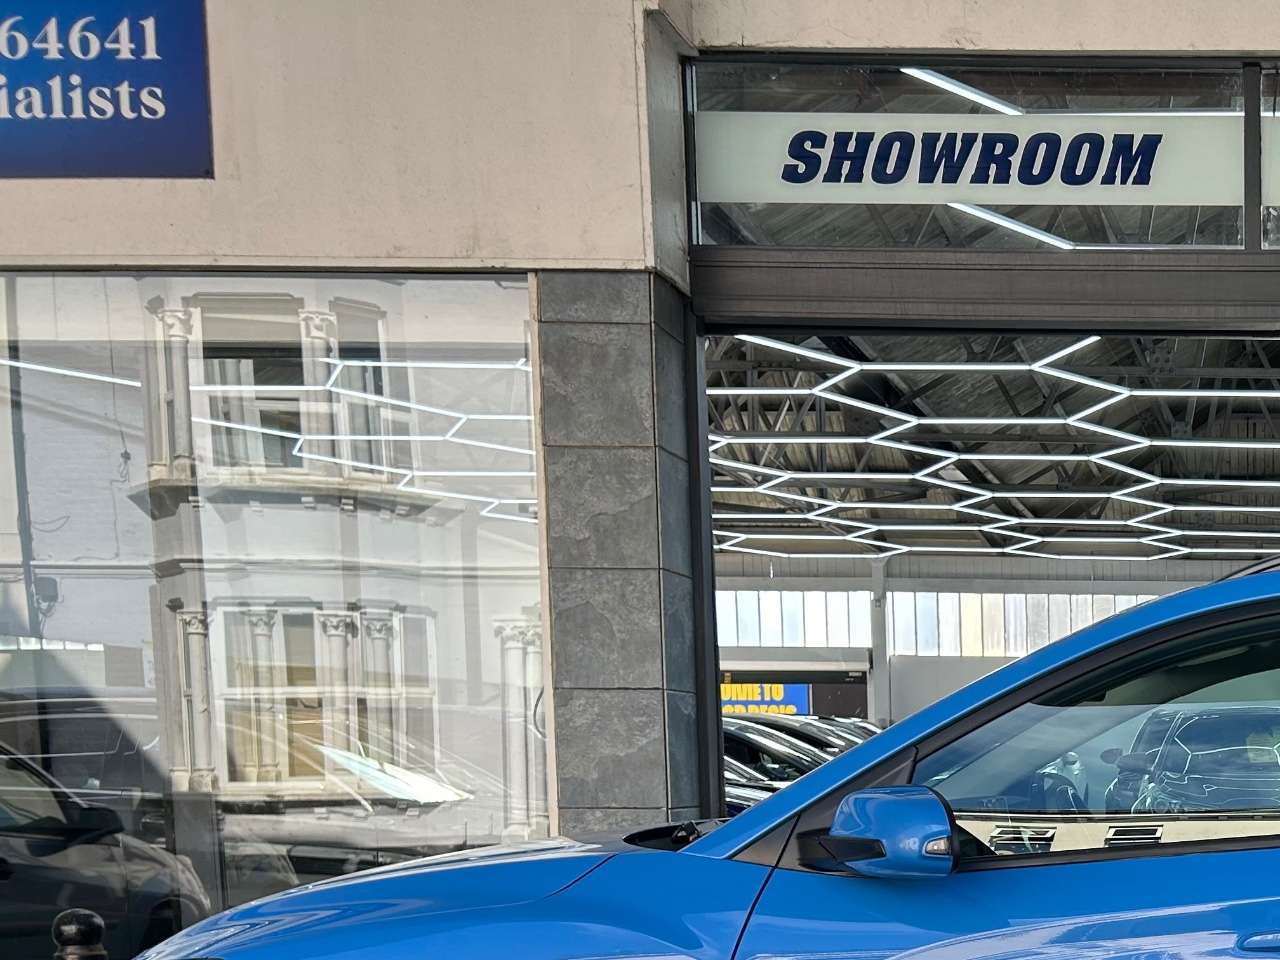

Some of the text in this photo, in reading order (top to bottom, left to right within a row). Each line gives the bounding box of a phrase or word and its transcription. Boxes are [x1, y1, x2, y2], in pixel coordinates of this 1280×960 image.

[0, 16, 162, 60] 64641
[0, 74, 166, 119] ialists
[781, 130, 1163, 186] SHOWROOM
